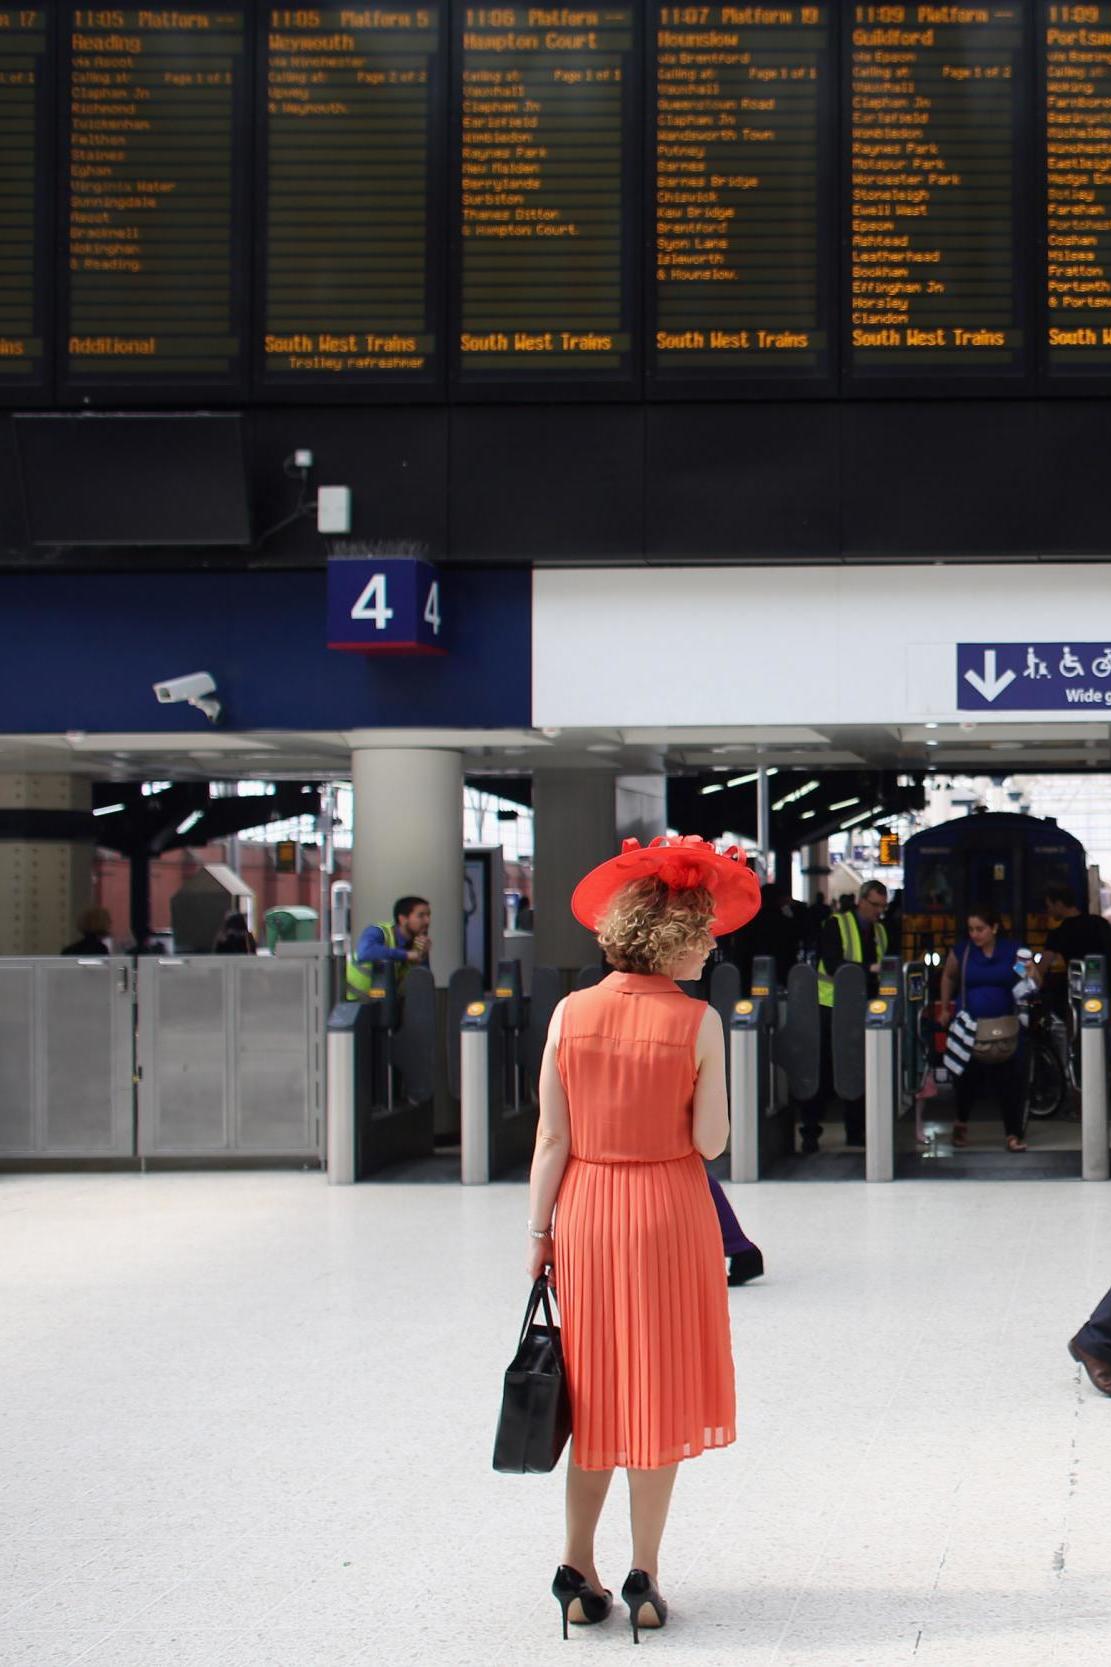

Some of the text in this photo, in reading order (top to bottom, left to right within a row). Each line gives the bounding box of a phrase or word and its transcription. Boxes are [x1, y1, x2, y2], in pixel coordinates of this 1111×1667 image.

[661, 7, 710, 25] 11:07
[720, 7, 794, 25] Platform
[916, 6, 989, 24] Platform
[71, 35, 144, 52] Reading
[268, 35, 356, 50] Weymouth
[463, 32, 598, 50] Hampton Court
[657, 31, 741, 46] Hounslow
[852, 29, 935, 45] Guildford
[895, 204, 929, 215] West
[265, 336, 417, 351] South West Trains
[461, 334, 613, 349] South West Trains
[656, 332, 809, 347] South West Trains
[852, 329, 1005, 345] South West Trains
[1049, 328, 1097, 344] South
[69, 338, 157, 353] Additional
[350, 573, 394, 630] 4
[423, 581, 442, 636] 4
[1065, 688, 1102, 703] Wide
